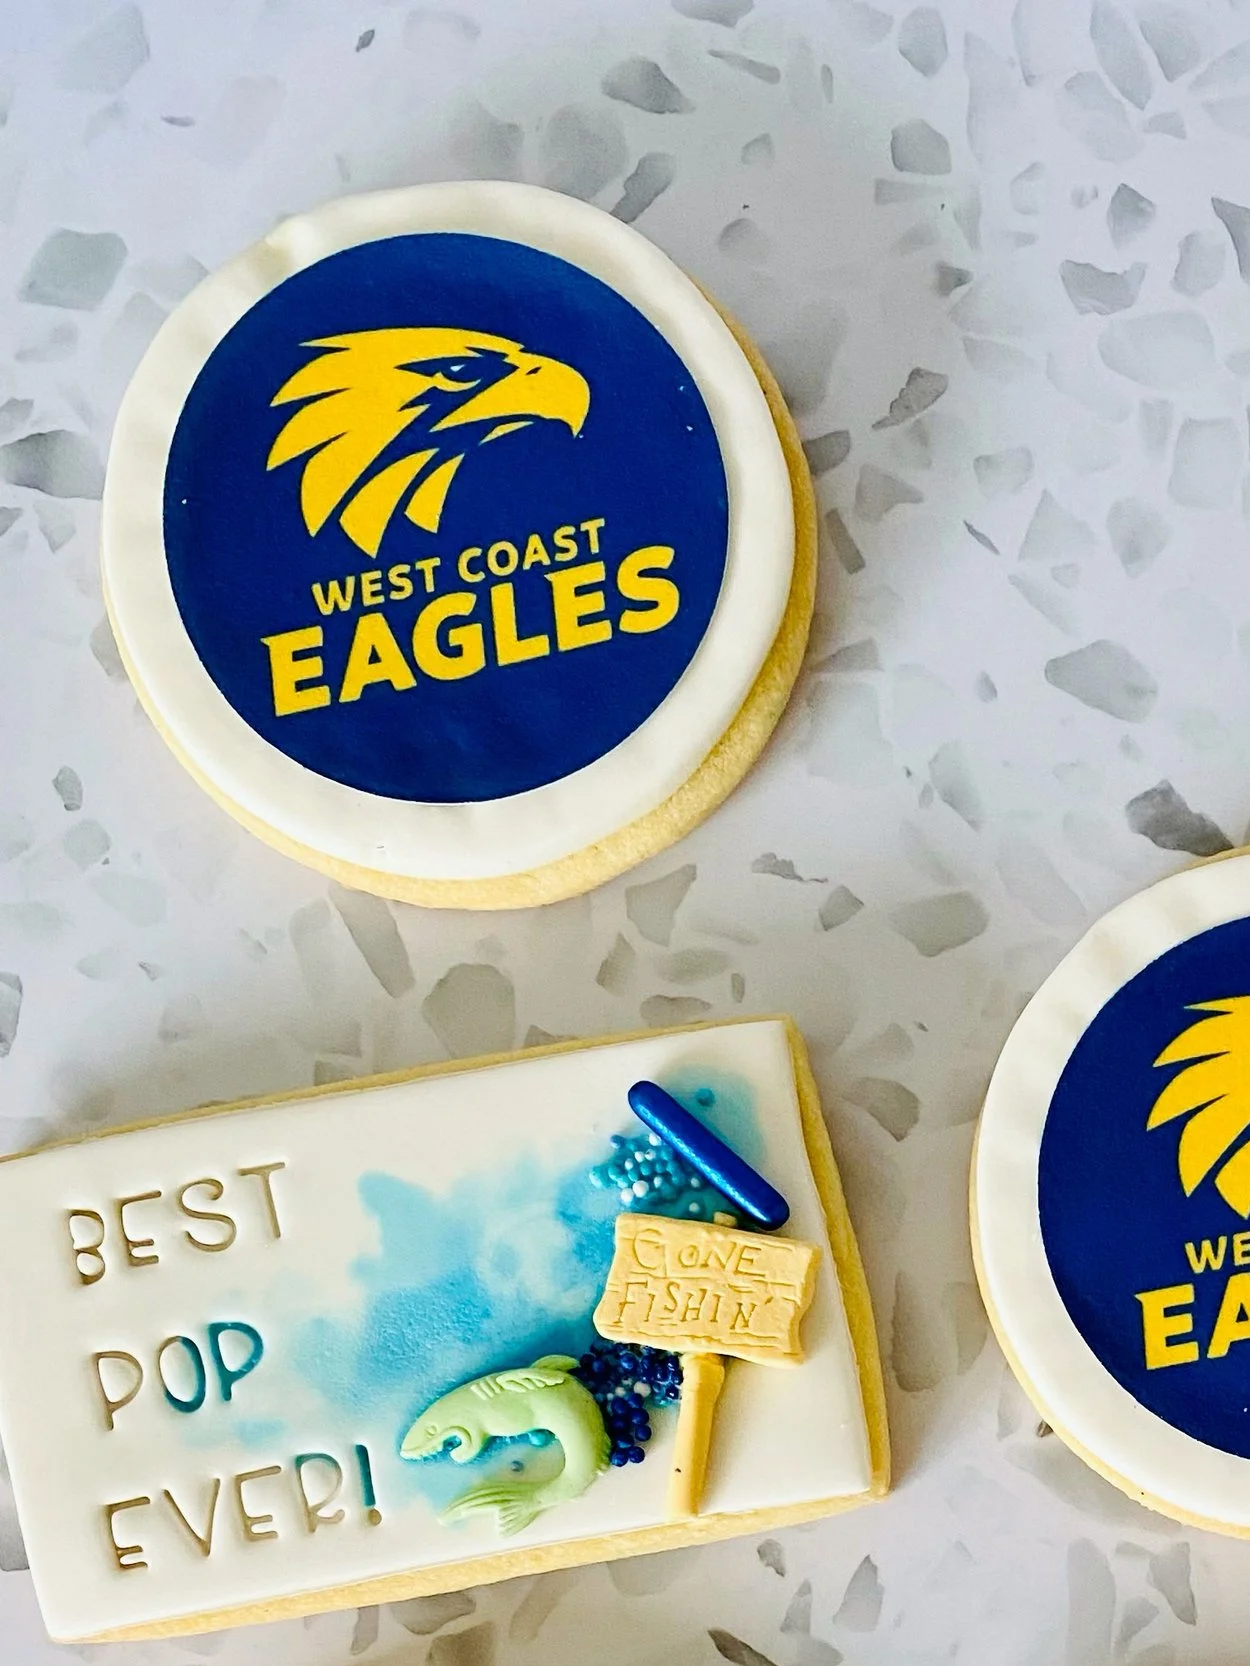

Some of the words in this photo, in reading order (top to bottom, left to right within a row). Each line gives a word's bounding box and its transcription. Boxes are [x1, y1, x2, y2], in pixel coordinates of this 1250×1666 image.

[311, 557, 440, 616] WEST
[458, 517, 606, 584] COAST
[260, 545, 681, 718] EAGLES
[68, 1161, 288, 1286] BEST
[632, 1228, 766, 1279] GONE
[93, 1320, 265, 1431] POP
[105, 1443, 384, 1571] EVER!
